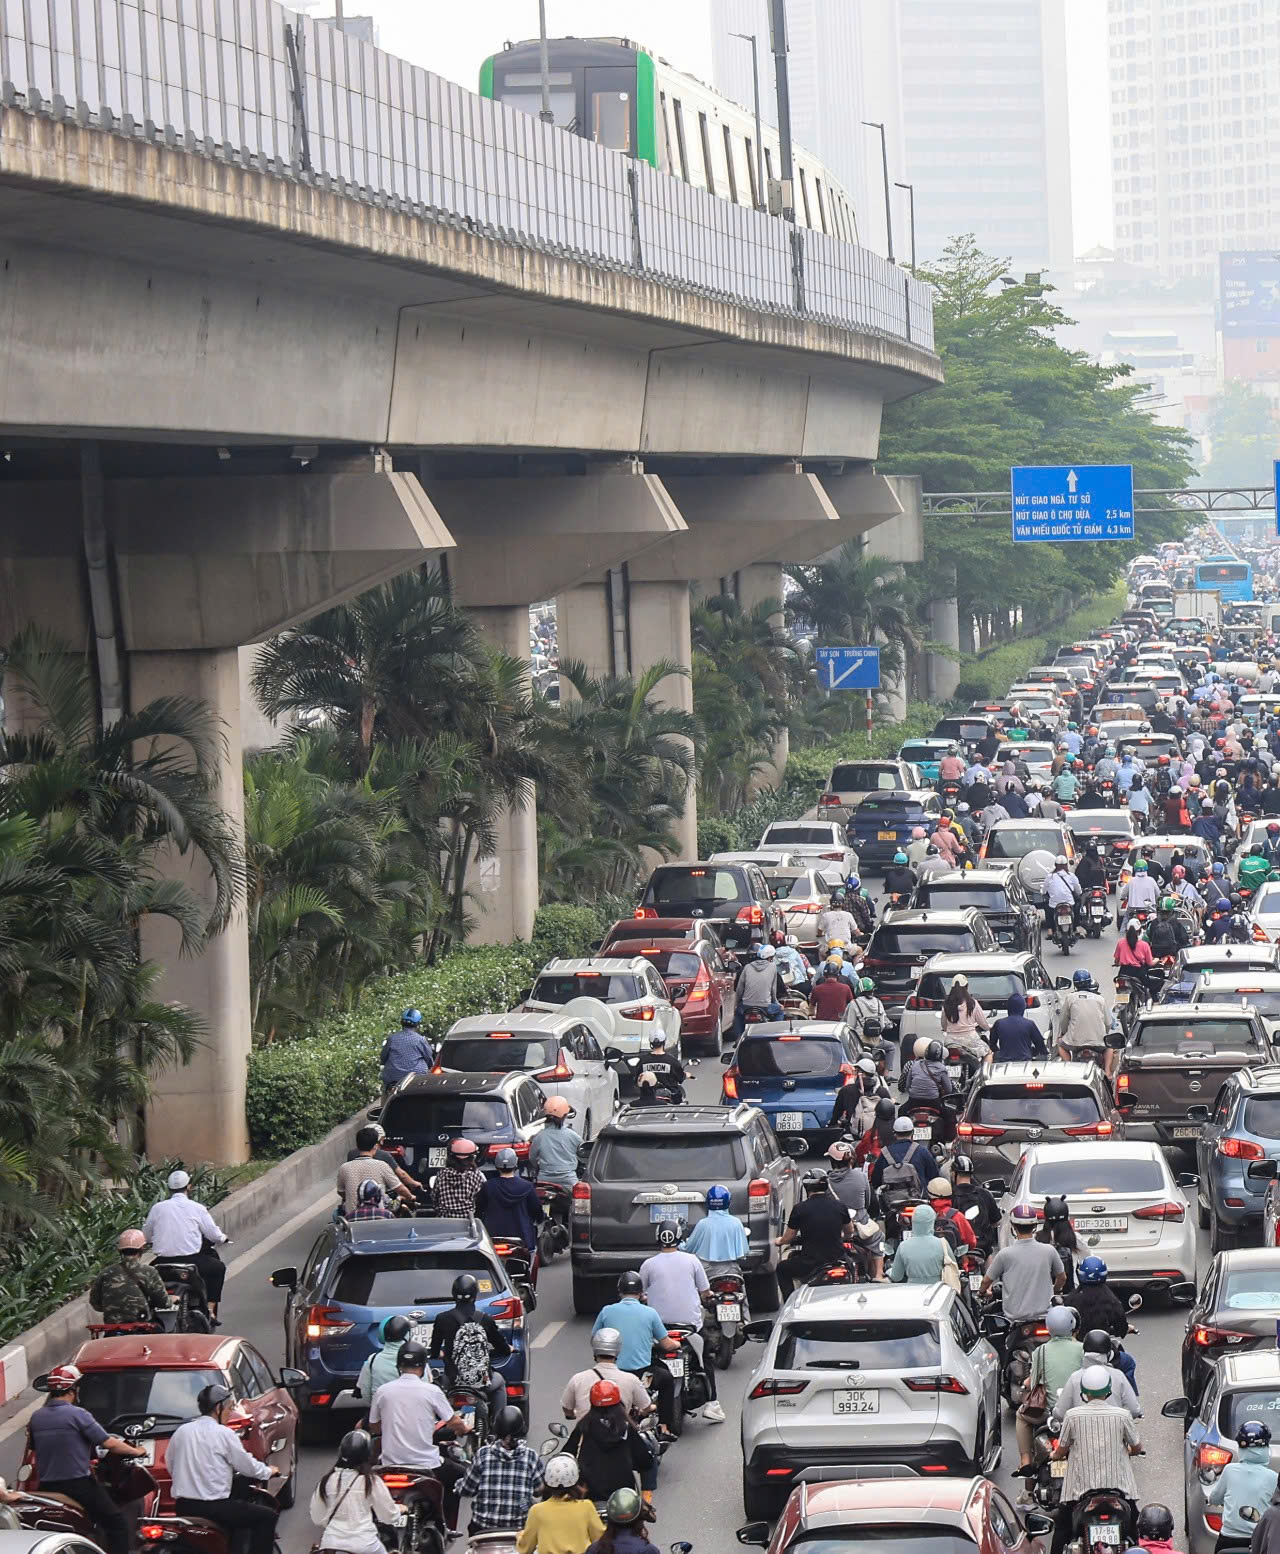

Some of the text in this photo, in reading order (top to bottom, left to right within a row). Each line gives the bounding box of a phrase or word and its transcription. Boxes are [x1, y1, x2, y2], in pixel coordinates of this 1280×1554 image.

[1015, 494, 1029, 505] NÚT
[1031, 495, 1048, 505] GIAO
[1015, 509, 1029, 520] NÚT
[1031, 511, 1048, 520] GIAO
[1119, 510, 1131, 519] km
[1084, 523, 1102, 535] GIÁM
[1120, 525, 1131, 534] km
[646, 1063, 667, 1072] UNION
[436, 1148, 446, 1157] 30
[430, 1157, 446, 1167] 470
[1074, 1218, 1123, 1229] 30F-328.11
[846, 1391, 866, 1402] 30K
[838, 1402, 874, 1412] 993.24
